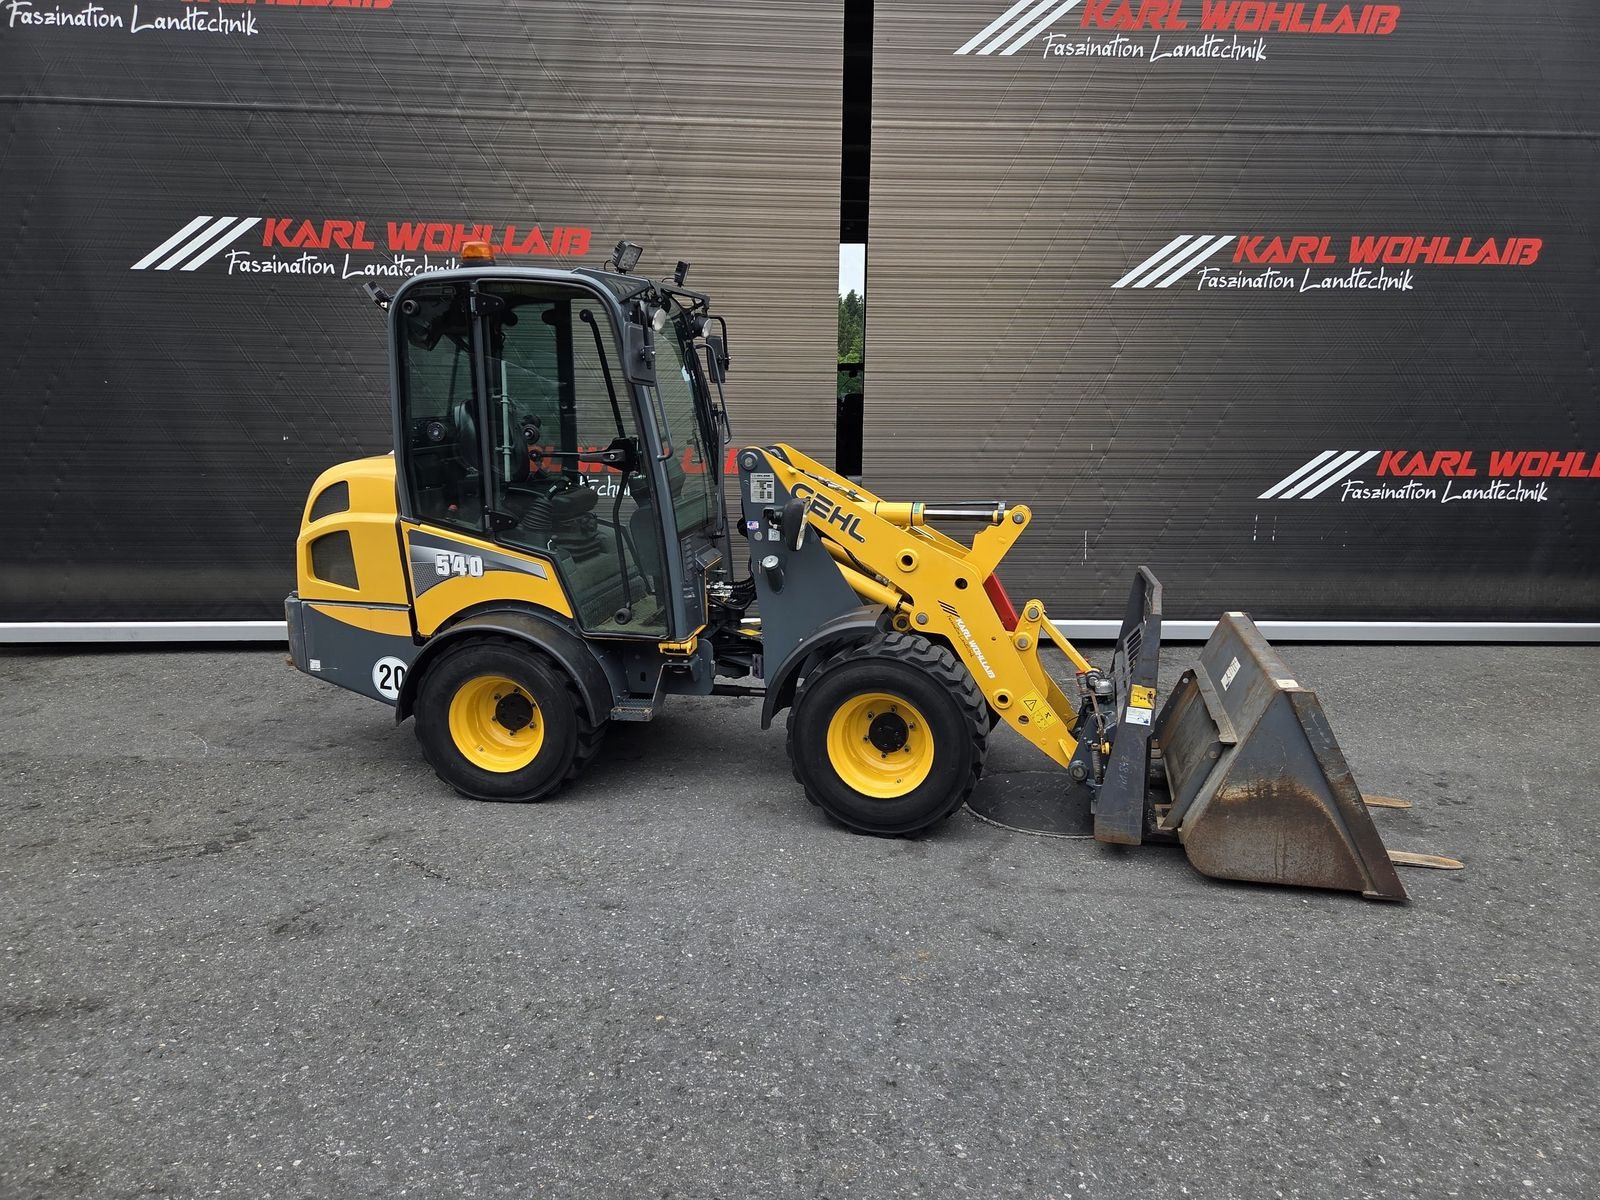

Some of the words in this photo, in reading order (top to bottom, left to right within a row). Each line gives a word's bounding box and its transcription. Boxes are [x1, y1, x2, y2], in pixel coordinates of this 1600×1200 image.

[6, 2, 123, 28] Faszination
[131, 4, 258, 35] Landtechnik
[1081, 0, 1188, 29] KARL
[1042, 32, 1144, 60] Faszination
[1150, 33, 1267, 62] Landtechnik
[262, 217, 375, 250] KARL
[224, 249, 335, 275] Faszination
[1232, 235, 1336, 264] KARL
[1196, 265, 1295, 291] Faszination
[1299, 266, 1414, 293] Landtechnik
[1376, 450, 1477, 477] KARL
[1341, 479, 1437, 502] Faszination
[1440, 479, 1548, 504] Landtechnik
[790, 483, 866, 543] GEHL
[435, 554, 485, 577] 540
[379, 664, 406, 691] 20
